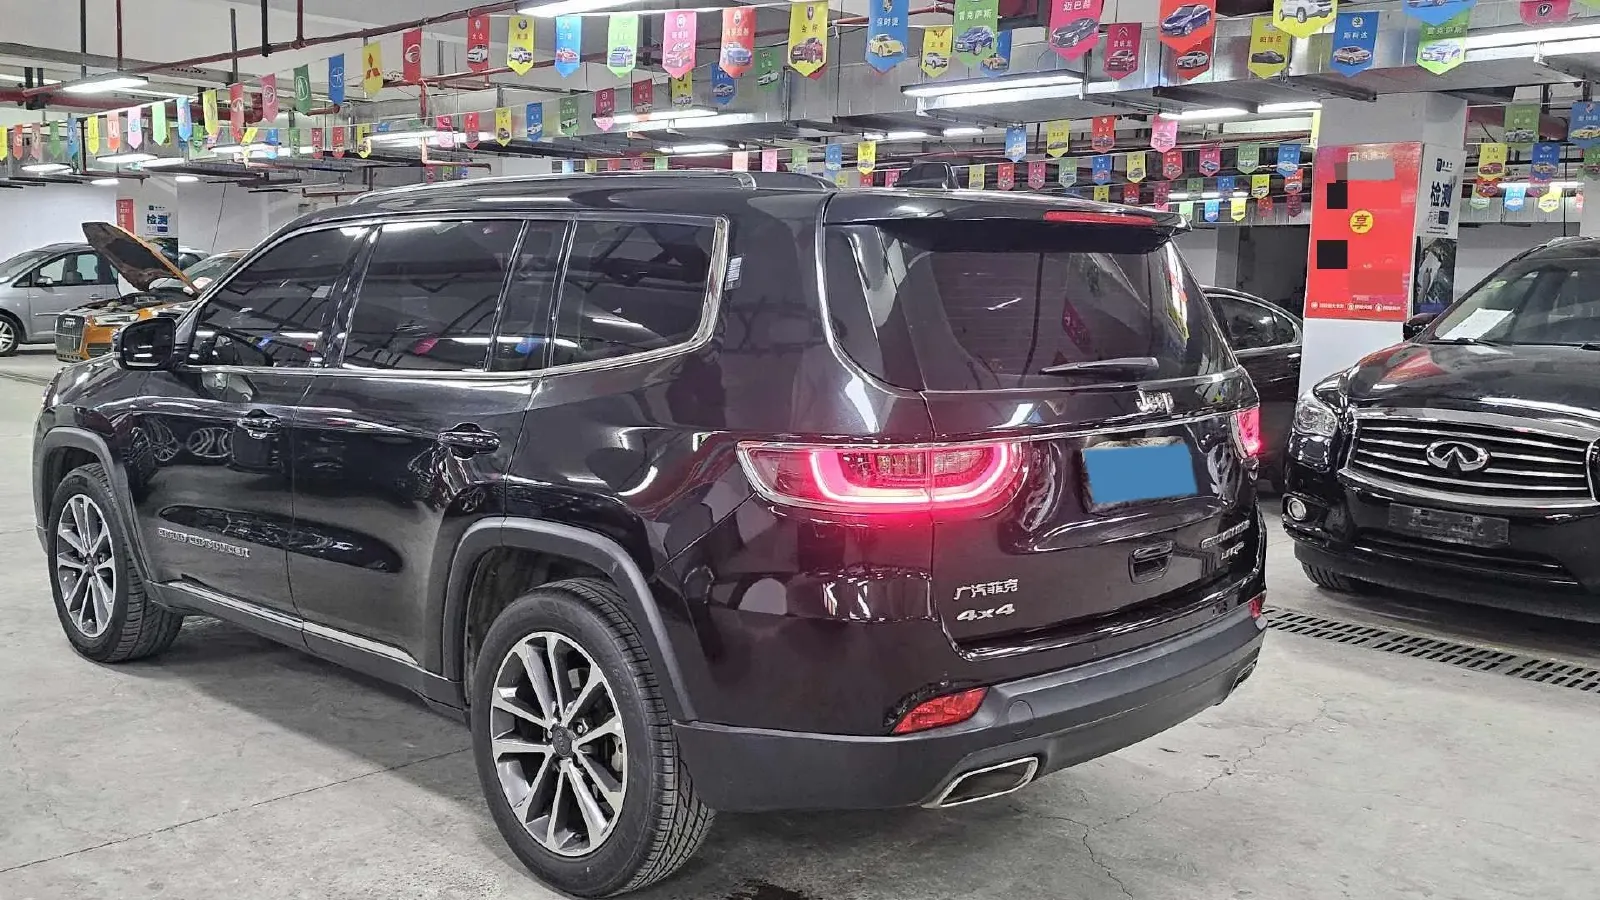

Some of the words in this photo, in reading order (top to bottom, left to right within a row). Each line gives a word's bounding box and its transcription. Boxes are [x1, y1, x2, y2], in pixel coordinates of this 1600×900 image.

[1135, 387, 1175, 417] Jeep
[953, 579, 1018, 600] 广汽菲克
[956, 603, 1015, 620] 4x4
